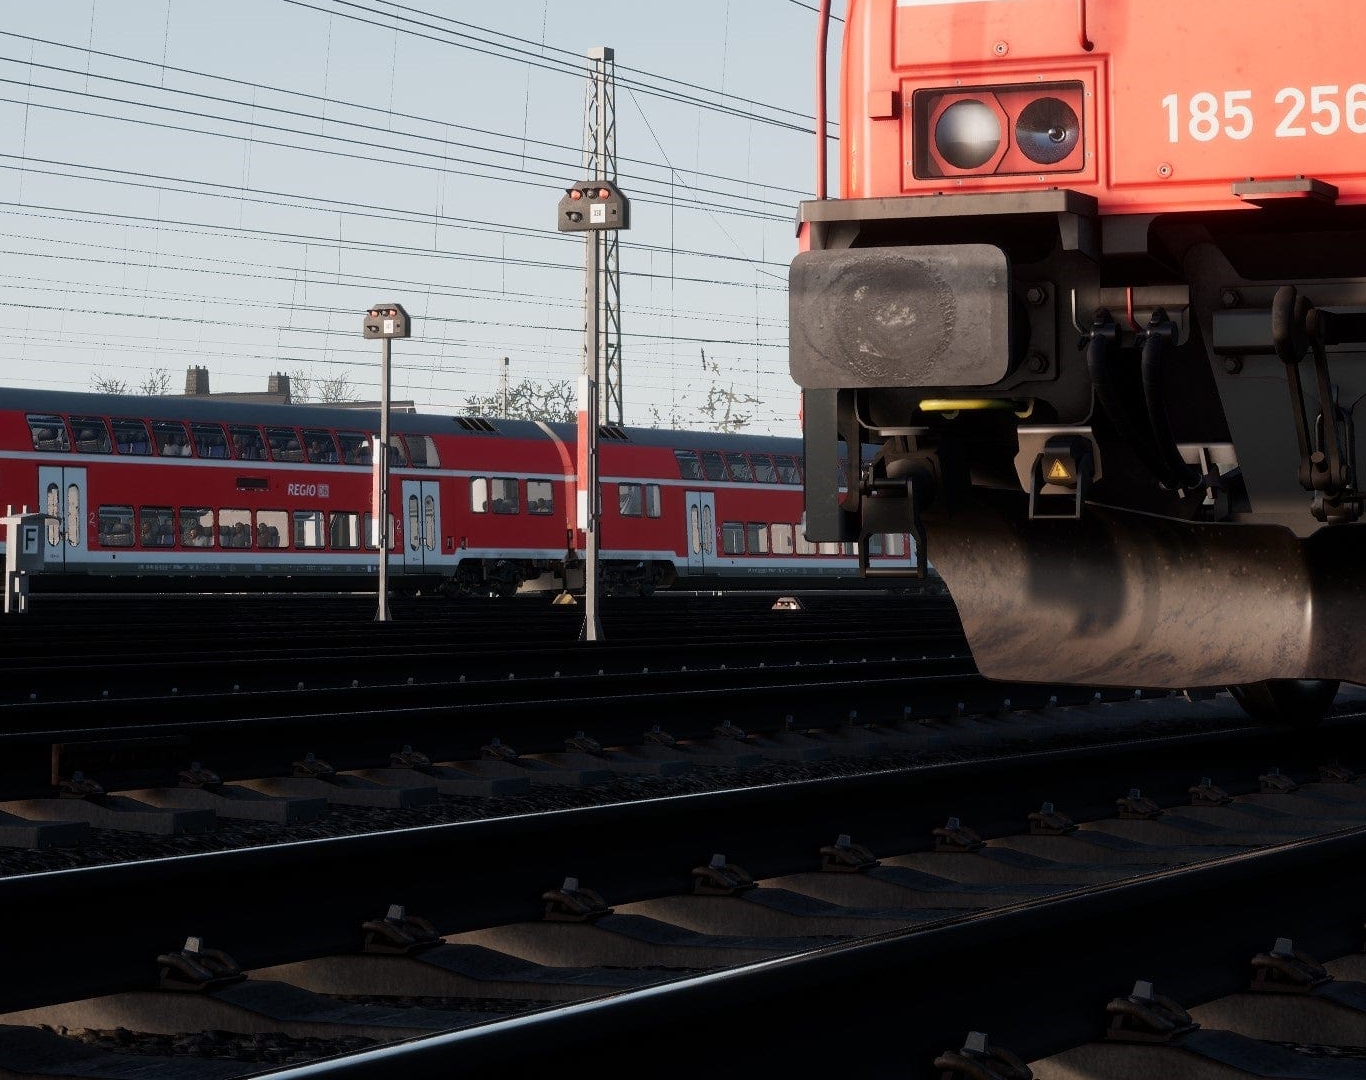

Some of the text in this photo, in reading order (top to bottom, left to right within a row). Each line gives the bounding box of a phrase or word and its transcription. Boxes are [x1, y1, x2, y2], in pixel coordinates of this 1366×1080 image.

[1162, 89, 1254, 143] 185
[287, 483, 316, 496] REGIO
[26, 529, 36, 551] F
